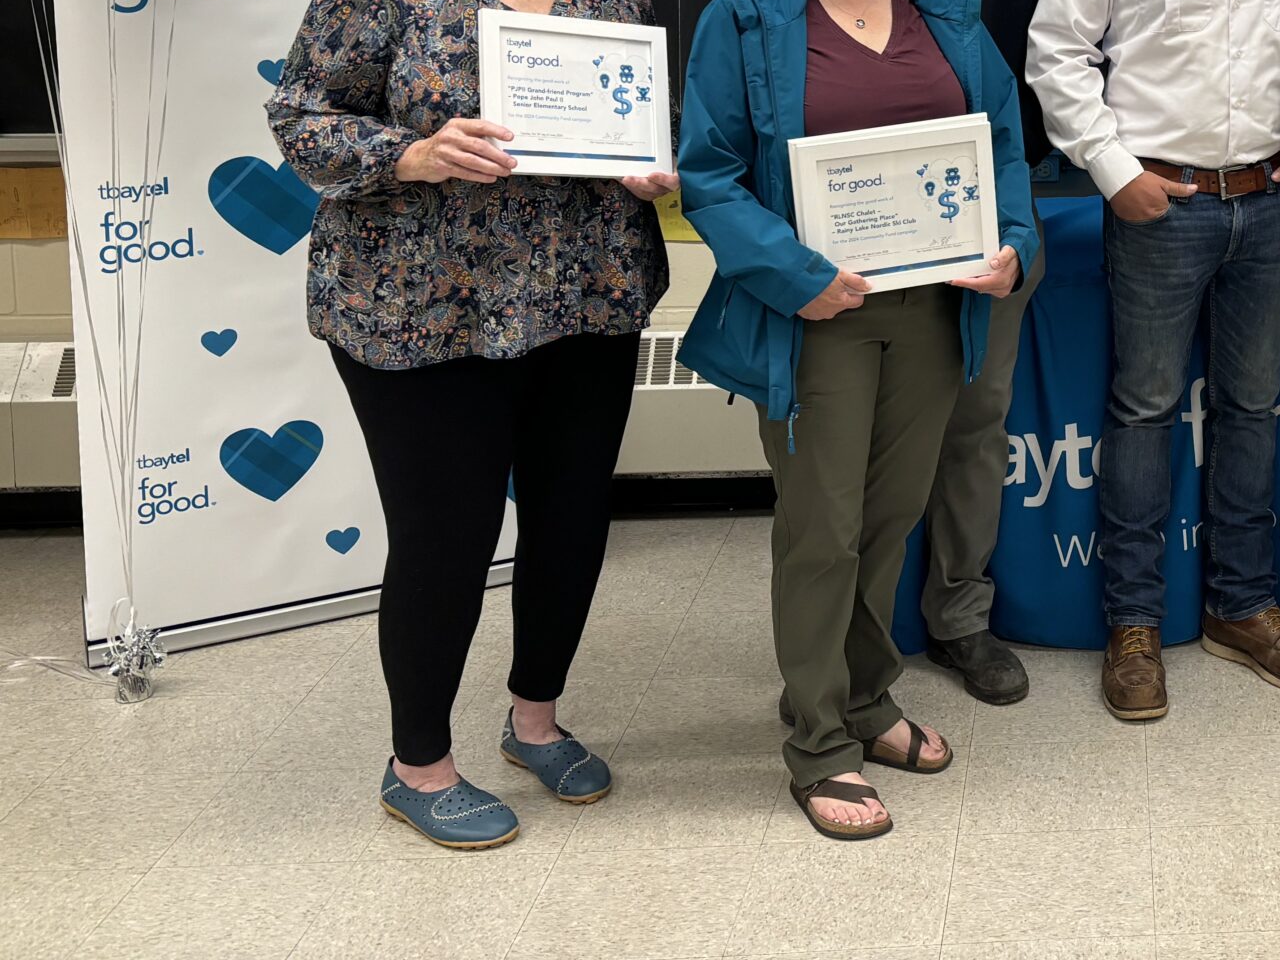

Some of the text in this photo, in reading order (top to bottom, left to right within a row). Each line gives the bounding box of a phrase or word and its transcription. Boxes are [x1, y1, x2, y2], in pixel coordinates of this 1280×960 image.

[507, 38, 532, 48] tbaytel
[507, 50, 525, 64] for
[534, 102, 567, 111] Elementary
[827, 164, 853, 176] tbaytel
[98, 176, 169, 203] tbaytel
[828, 180, 847, 192] for
[100, 211, 151, 243] for
[848, 217, 878, 226] Gathering
[870, 222, 891, 230] Nordic
[136, 447, 190, 470] tbaytel
[138, 477, 178, 501] for
